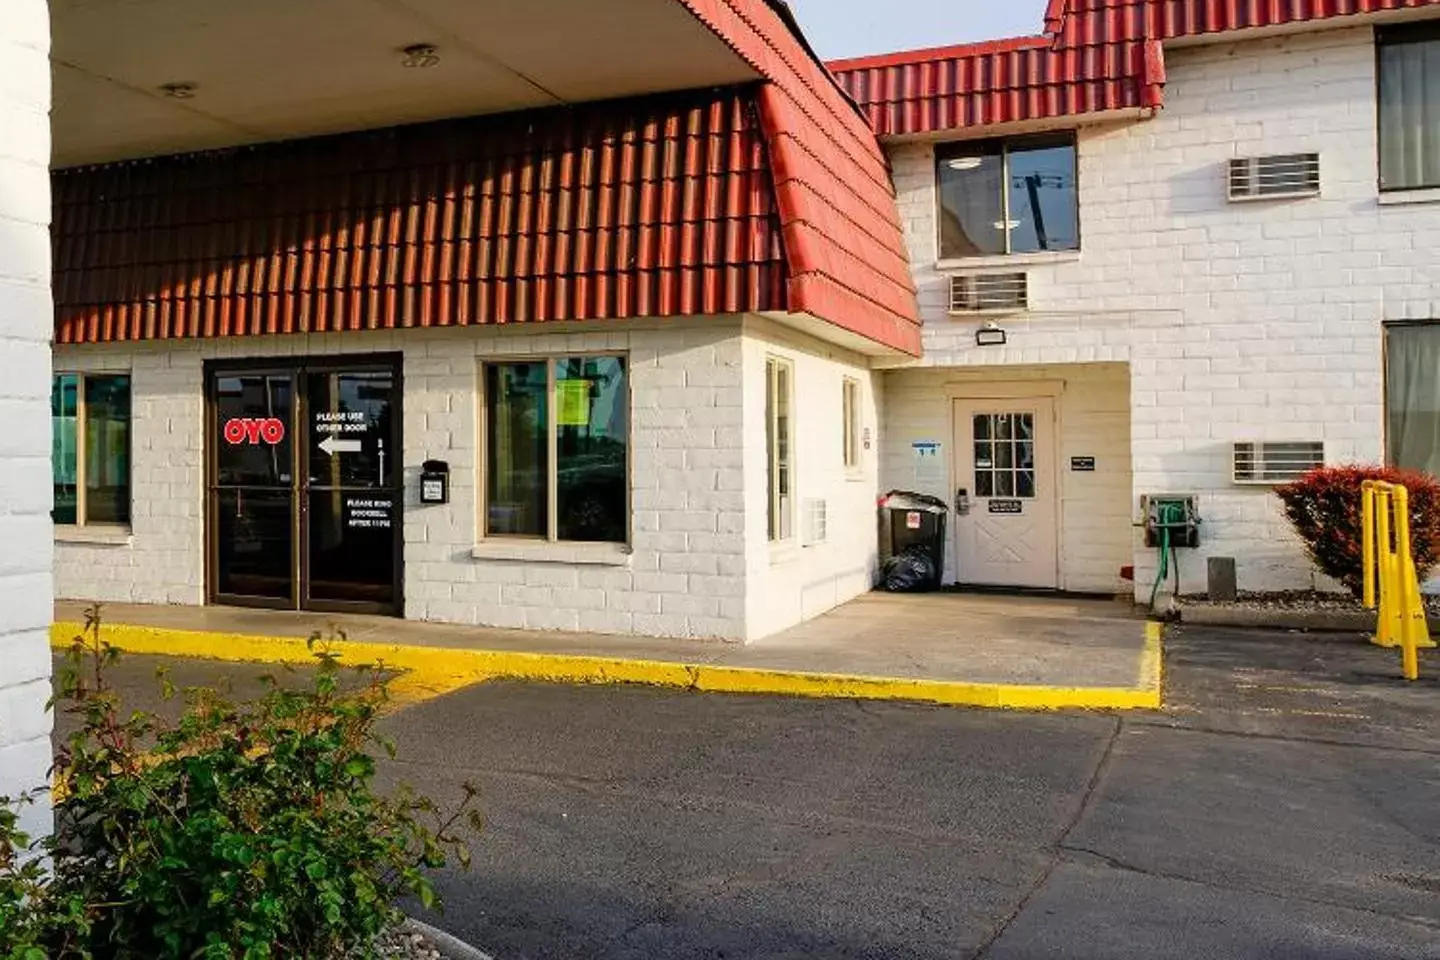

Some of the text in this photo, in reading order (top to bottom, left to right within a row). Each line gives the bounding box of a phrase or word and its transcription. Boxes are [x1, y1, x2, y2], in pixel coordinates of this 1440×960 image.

[316, 412, 364, 421] PLEASE USE
[224, 417, 285, 444] OYO
[316, 424, 367, 432] OTHER DOOR
[347, 499, 373, 507] PLEASE
[349, 519, 371, 527] AFTER
